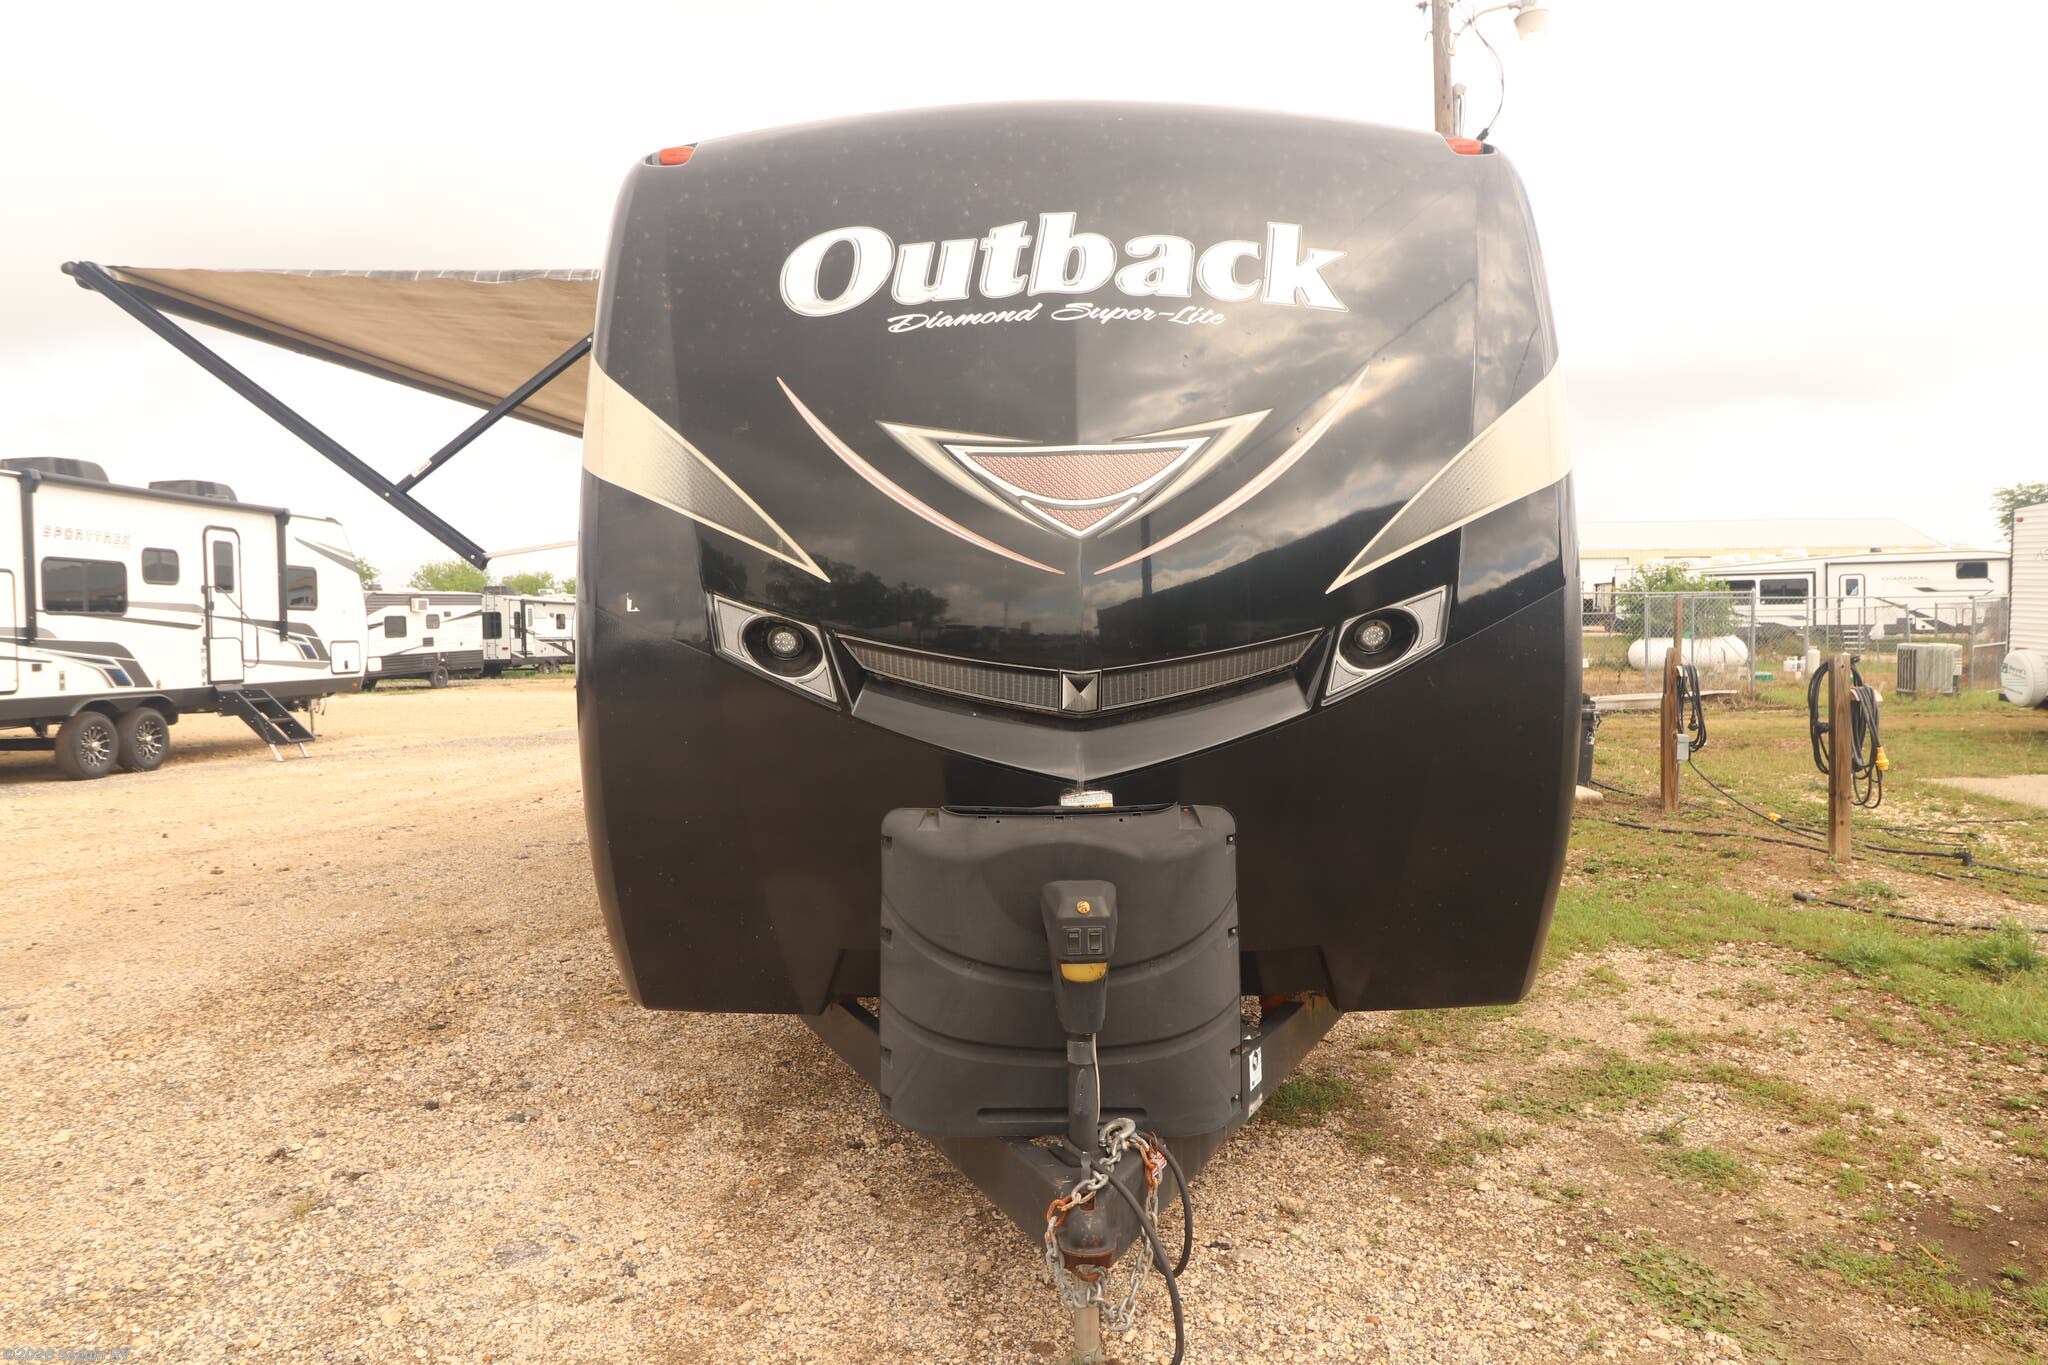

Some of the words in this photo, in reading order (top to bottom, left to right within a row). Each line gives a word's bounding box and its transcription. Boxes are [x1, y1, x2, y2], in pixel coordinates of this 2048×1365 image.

[779, 212, 1349, 317] Outback
[888, 303, 1042, 333] Diamond
[1051, 303, 1226, 325] Super-Lite
